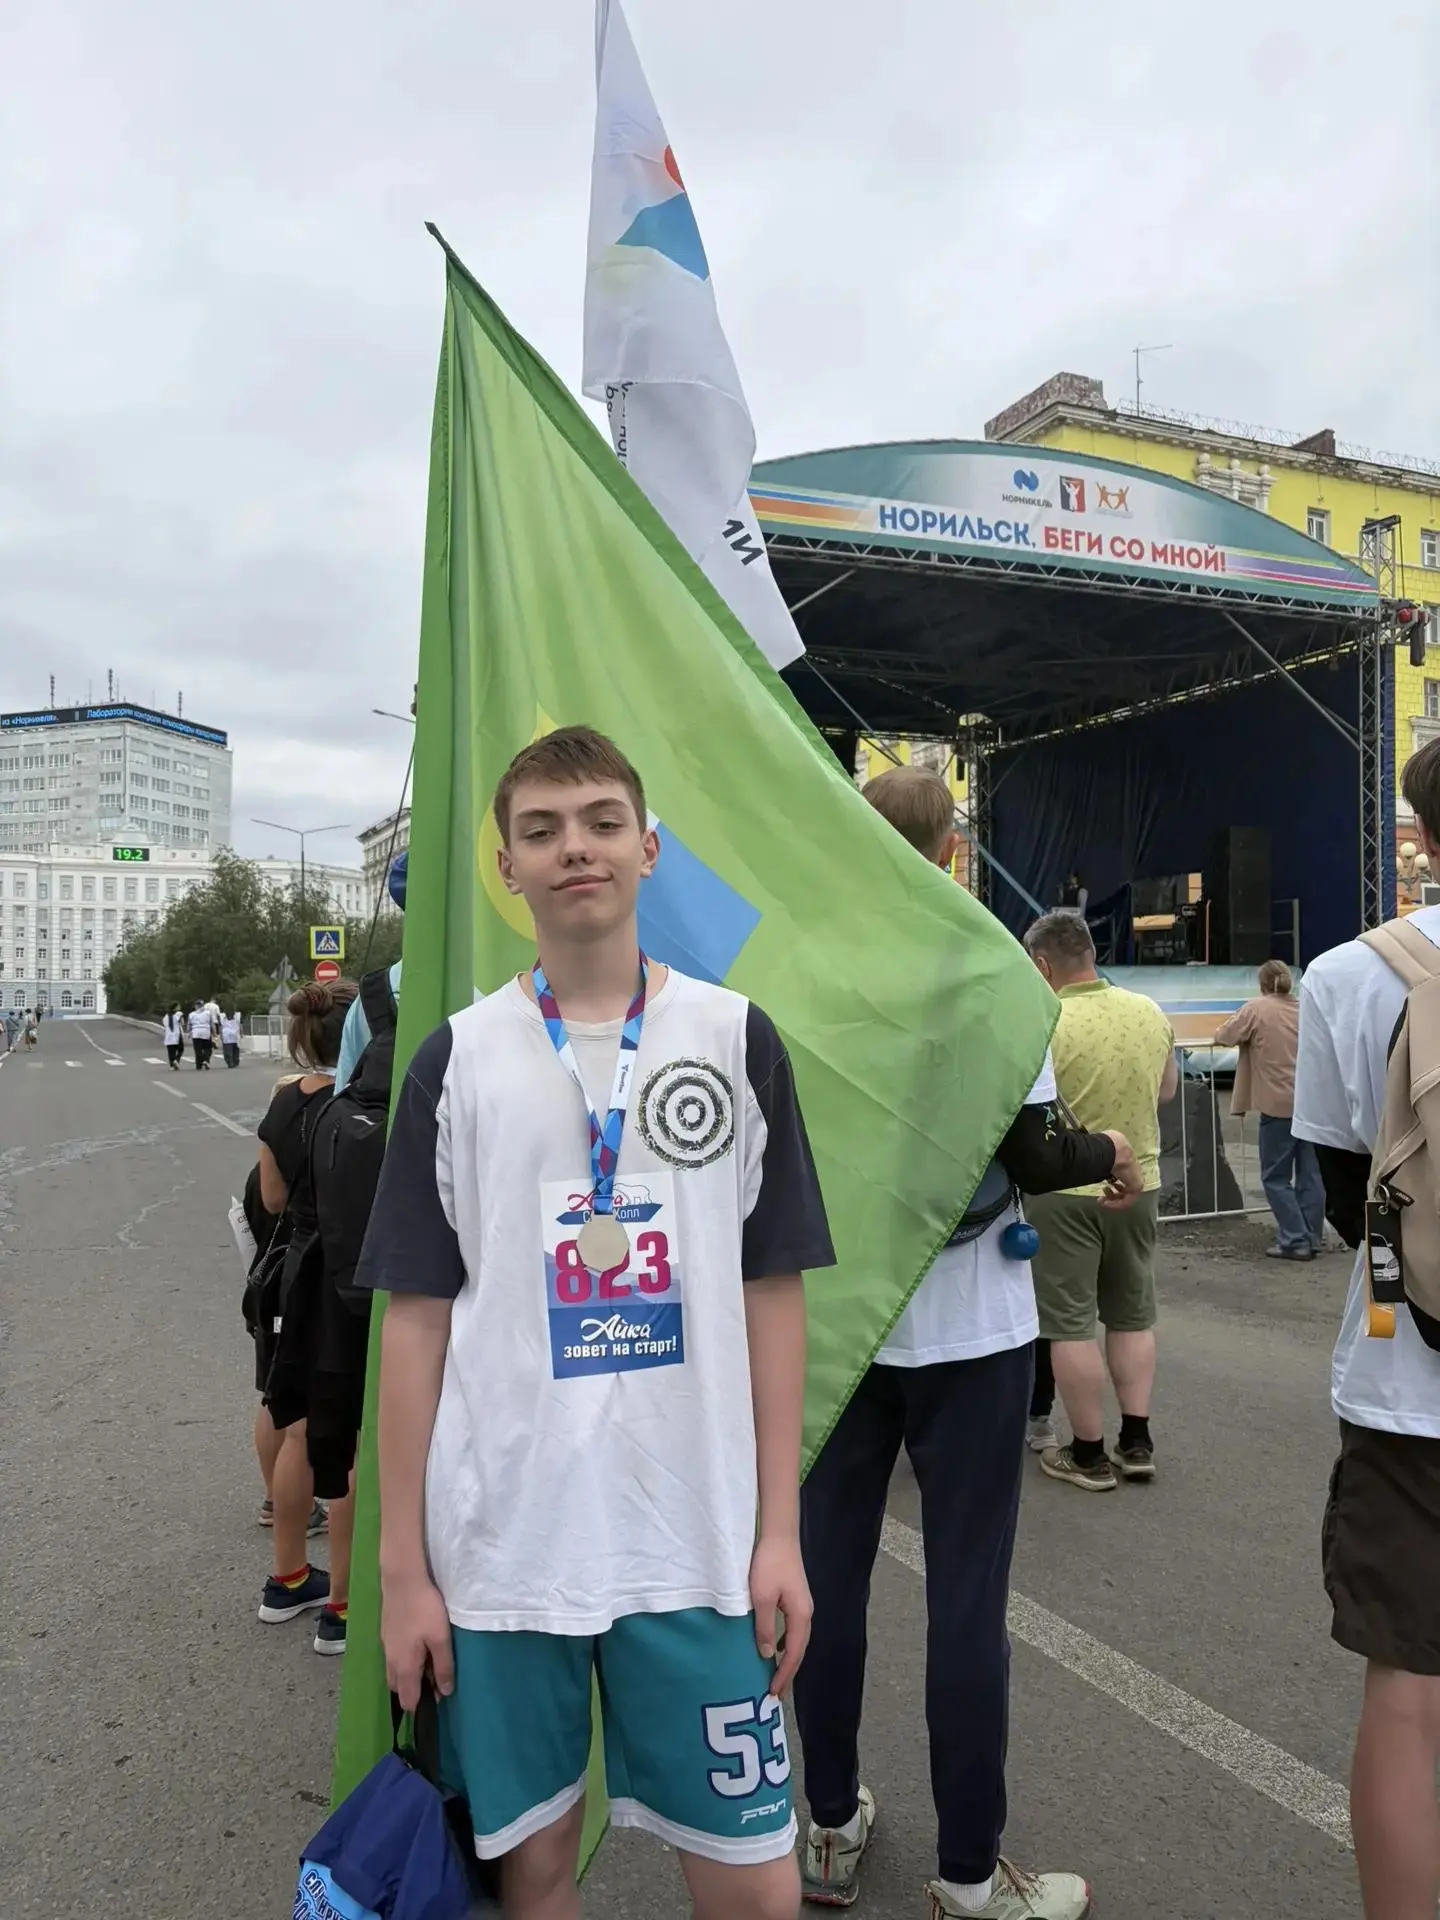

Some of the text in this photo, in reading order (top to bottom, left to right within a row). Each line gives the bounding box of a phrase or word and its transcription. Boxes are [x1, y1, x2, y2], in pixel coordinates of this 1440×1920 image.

[1002, 493, 1053, 508] НОРНИКЕЛЬ
[879, 504, 1227, 572] НОРИЛЬСК, БЕГИ СО МНОЙ!
[115, 848, 143, 860] 19.2
[555, 1230, 672, 1304] 823
[581, 1313, 652, 1342] Айка
[563, 1335, 678, 1359] зовет на старт!
[701, 1693, 792, 1799] 53
